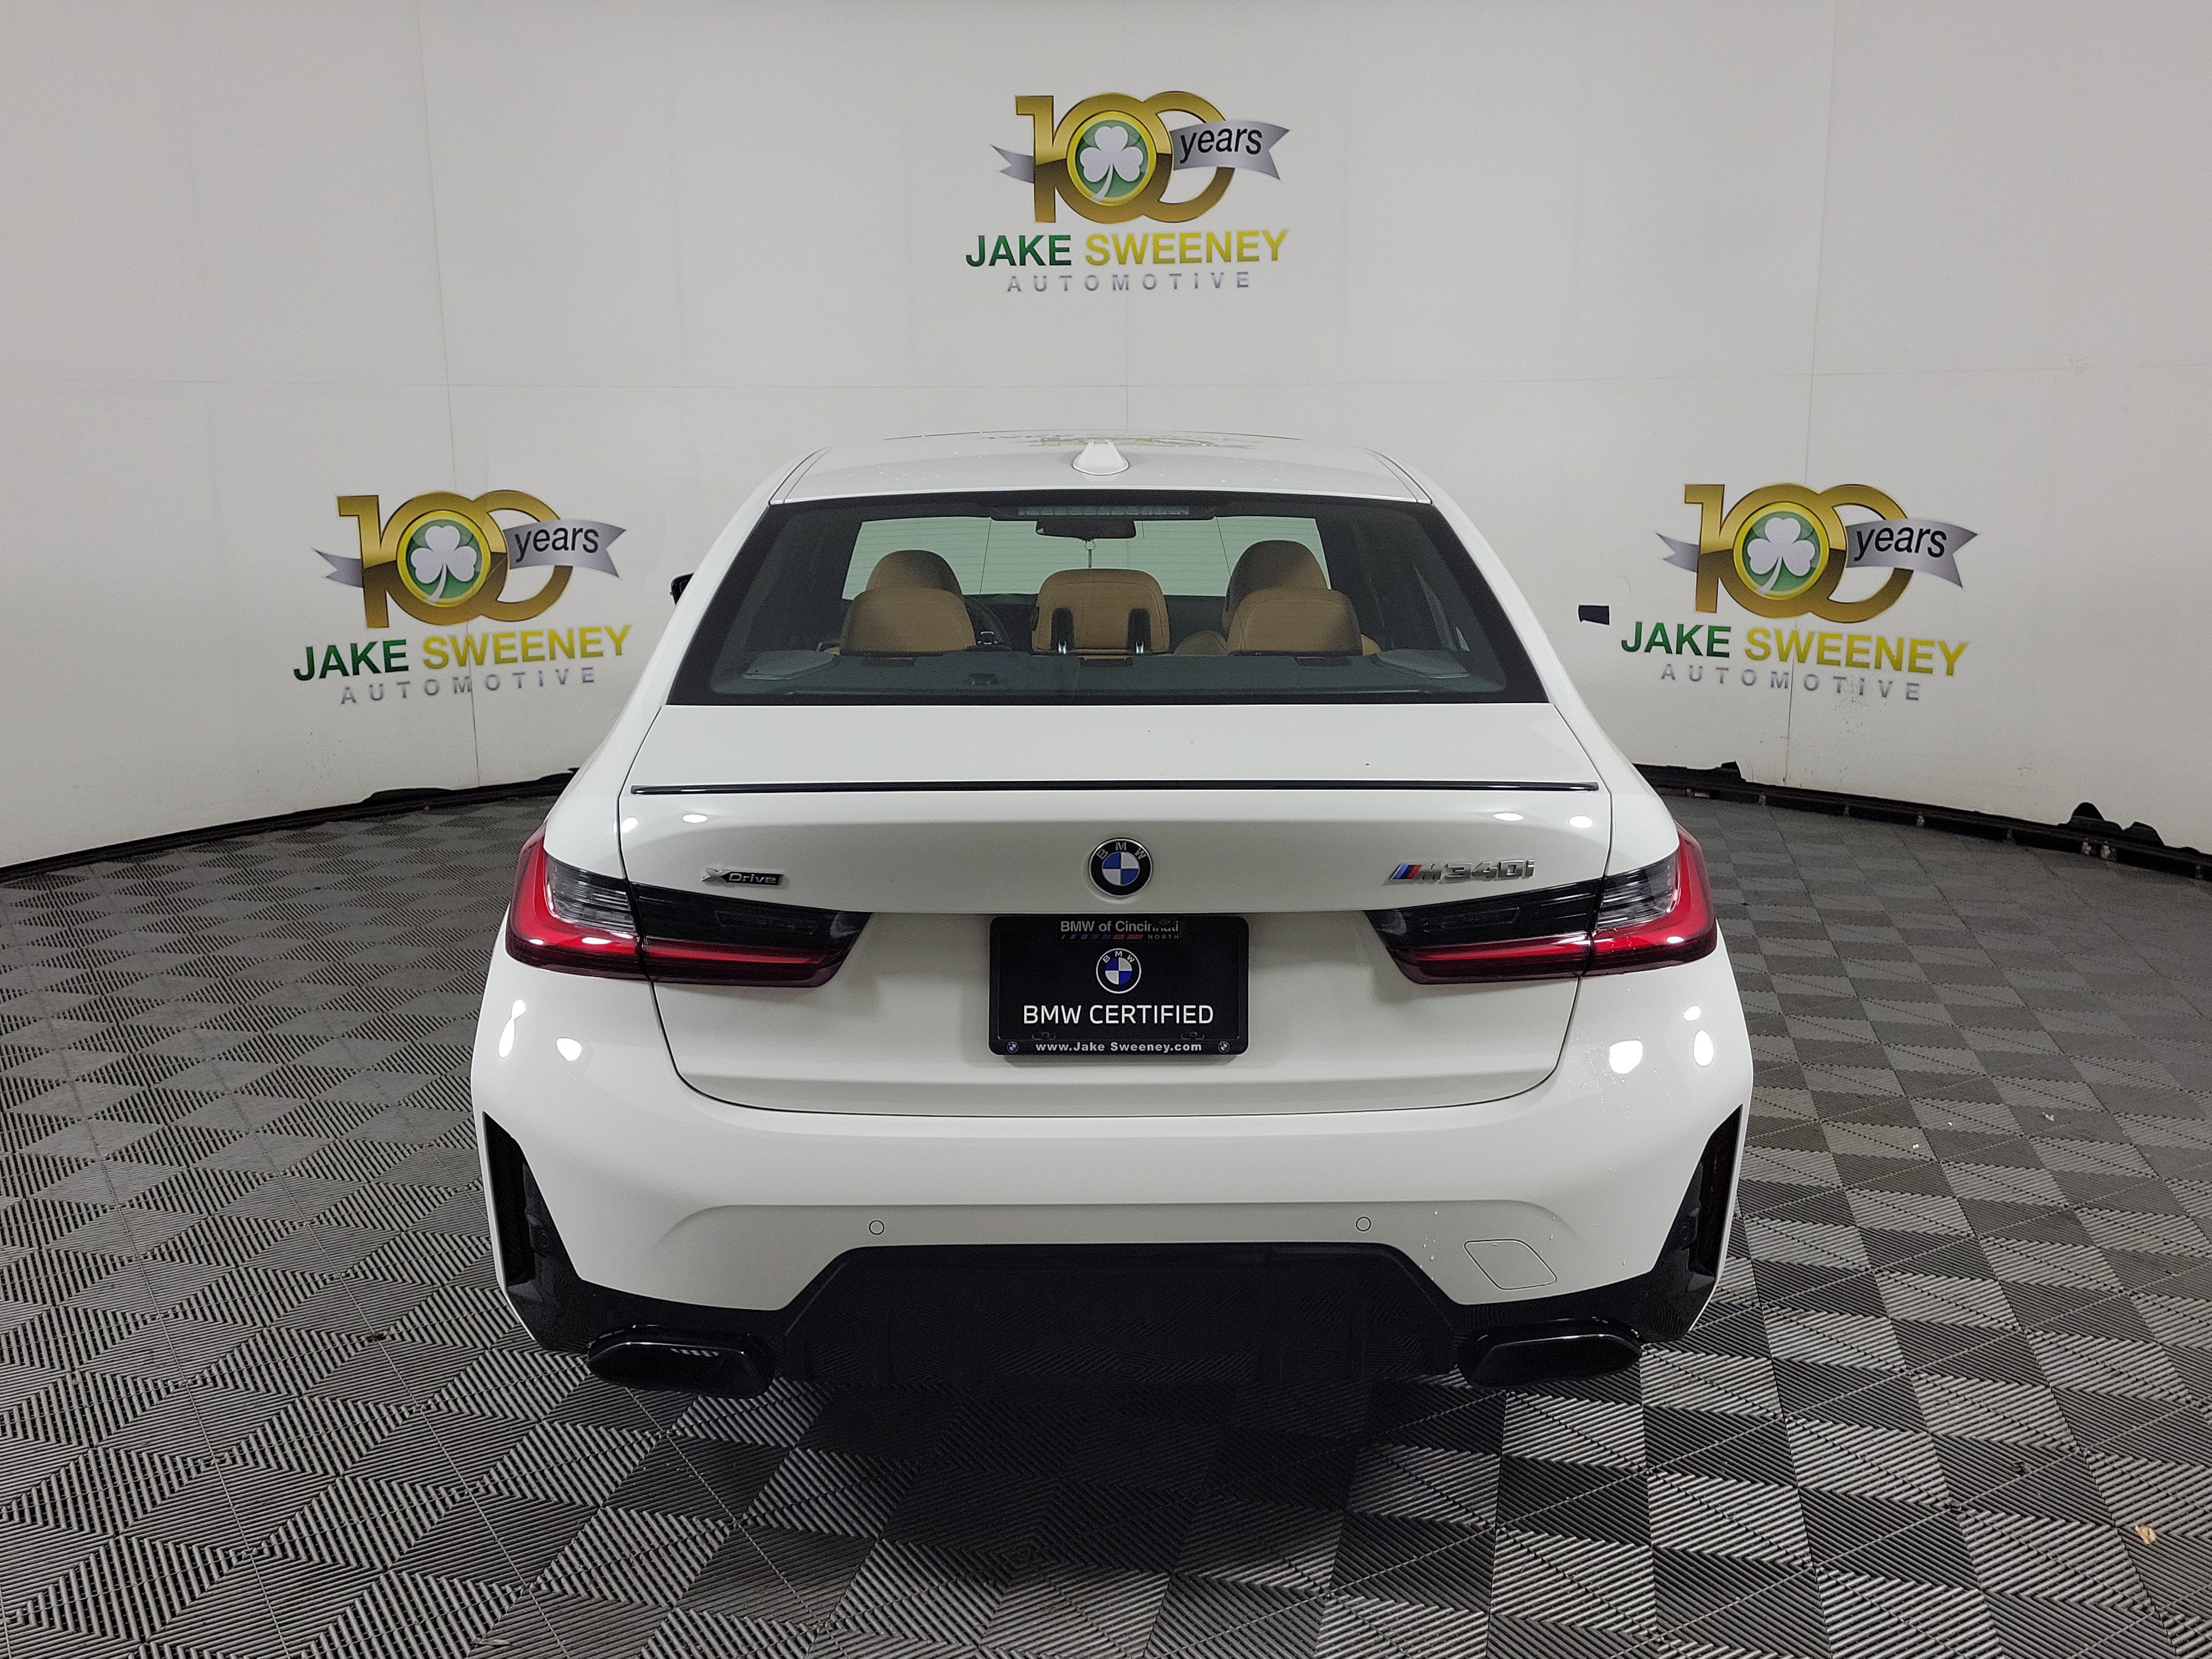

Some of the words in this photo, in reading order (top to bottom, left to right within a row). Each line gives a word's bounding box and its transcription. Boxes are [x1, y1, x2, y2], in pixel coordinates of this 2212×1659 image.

[1014, 91, 1235, 224] 100
[1179, 128, 1263, 164] years
[966, 235, 1072, 267] JAKE
[1085, 229, 1288, 266] SWEENEY
[1007, 271, 1250, 292] AUTOMOTIVE
[336, 489, 573, 629] 100
[514, 526, 600, 563] years
[1684, 483, 1914, 624] 100
[1853, 526, 1948, 562] years
[293, 638, 409, 681] JAKE
[422, 624, 632, 670] SWEENEY
[1621, 621, 1731, 658] JAKE
[1745, 627, 1968, 676] SWEENEY
[340, 667, 595, 705] AUTOMOTIVE
[1660, 663, 1921, 702] AUTOMOTIVE
[1096, 842, 1147, 860] BMW
[1060, 921, 1095, 932] BMW
[1099, 921, 1111, 932] of
[1102, 951, 1135, 964] BMW
[1023, 1005, 1082, 1024] BMW
[1090, 1005, 1214, 1024] CERTIFIED
[1035, 1042, 1105, 1052] www.Jake
[1110, 1042, 1202, 1053] Sweeney.com
